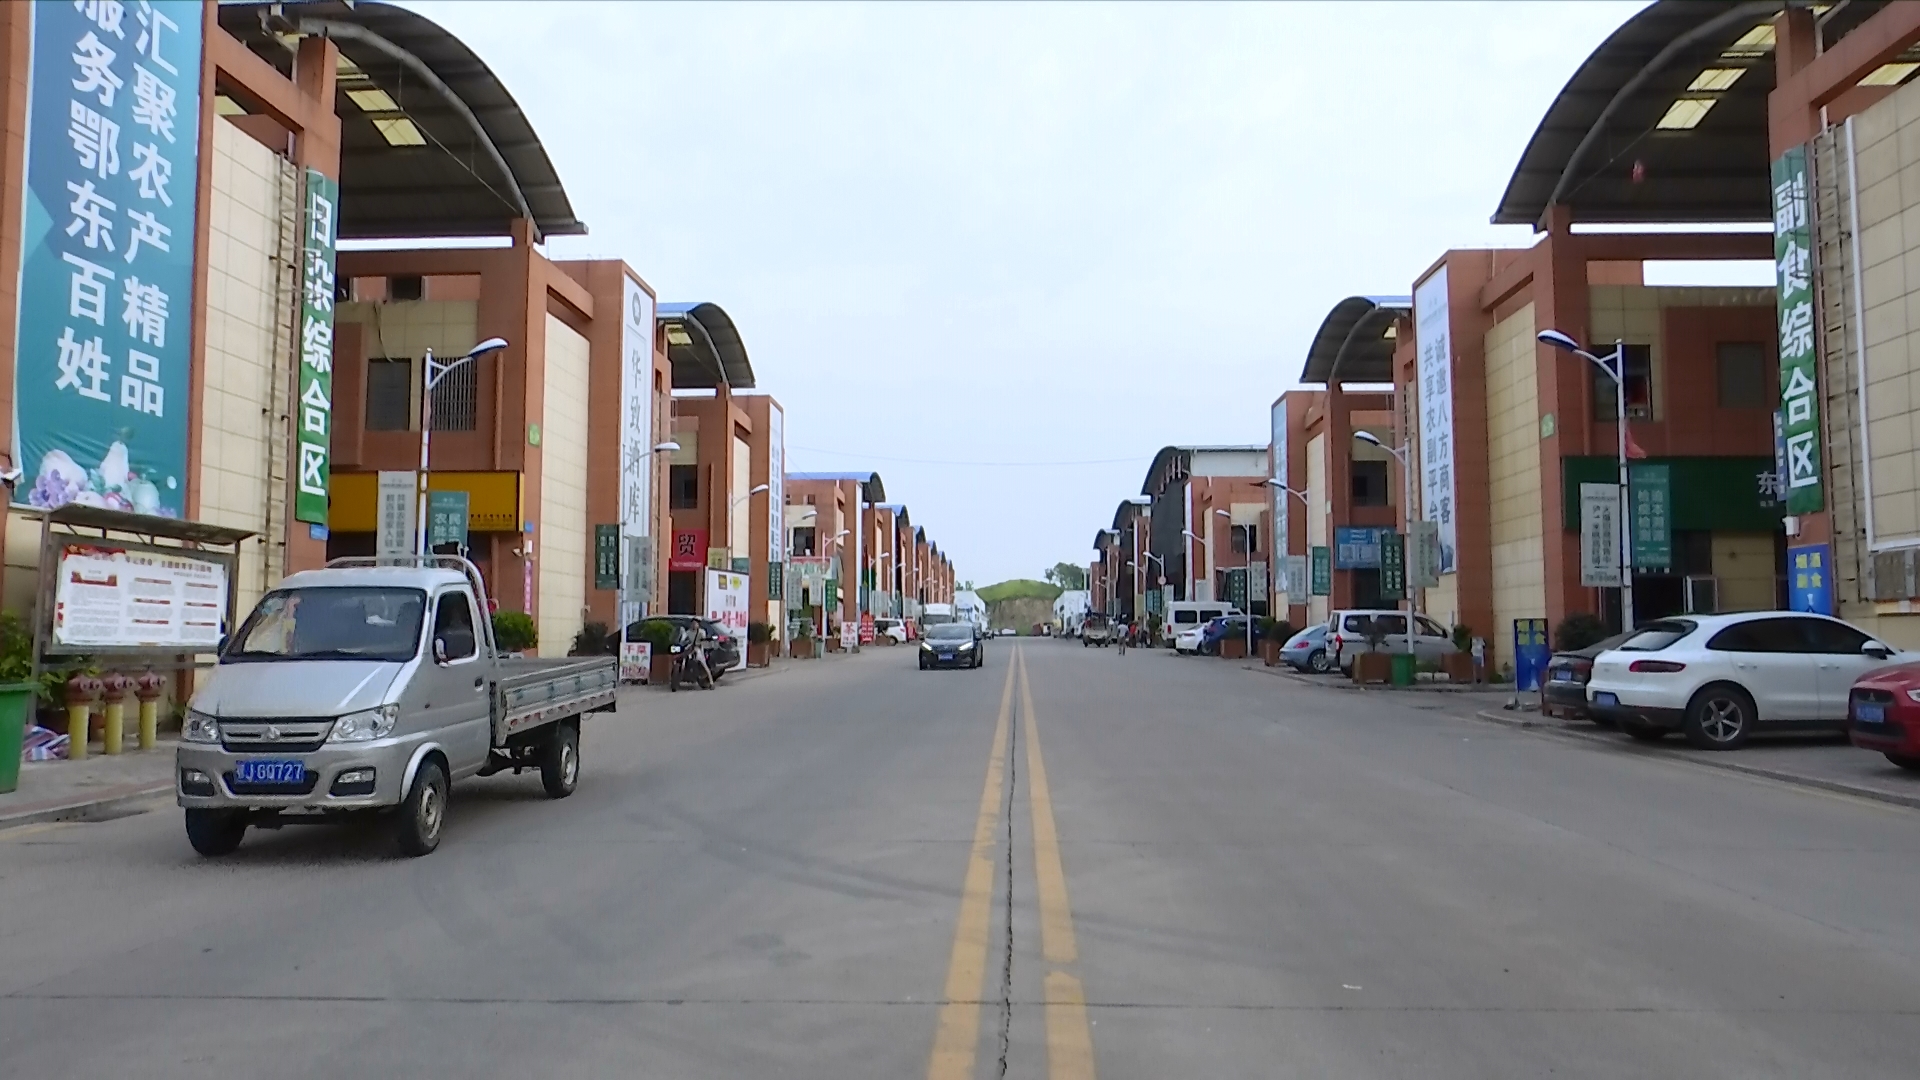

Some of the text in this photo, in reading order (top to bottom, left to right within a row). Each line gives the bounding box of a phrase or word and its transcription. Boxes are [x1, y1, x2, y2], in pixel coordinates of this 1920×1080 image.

[56, 0, 126, 403] 服务鄂东百姓
[120, 0, 180, 418] 汇聚农产精品
[301, 193, 334, 497] 日杂综合区
[1775, 170, 1819, 489] 副食综合区
